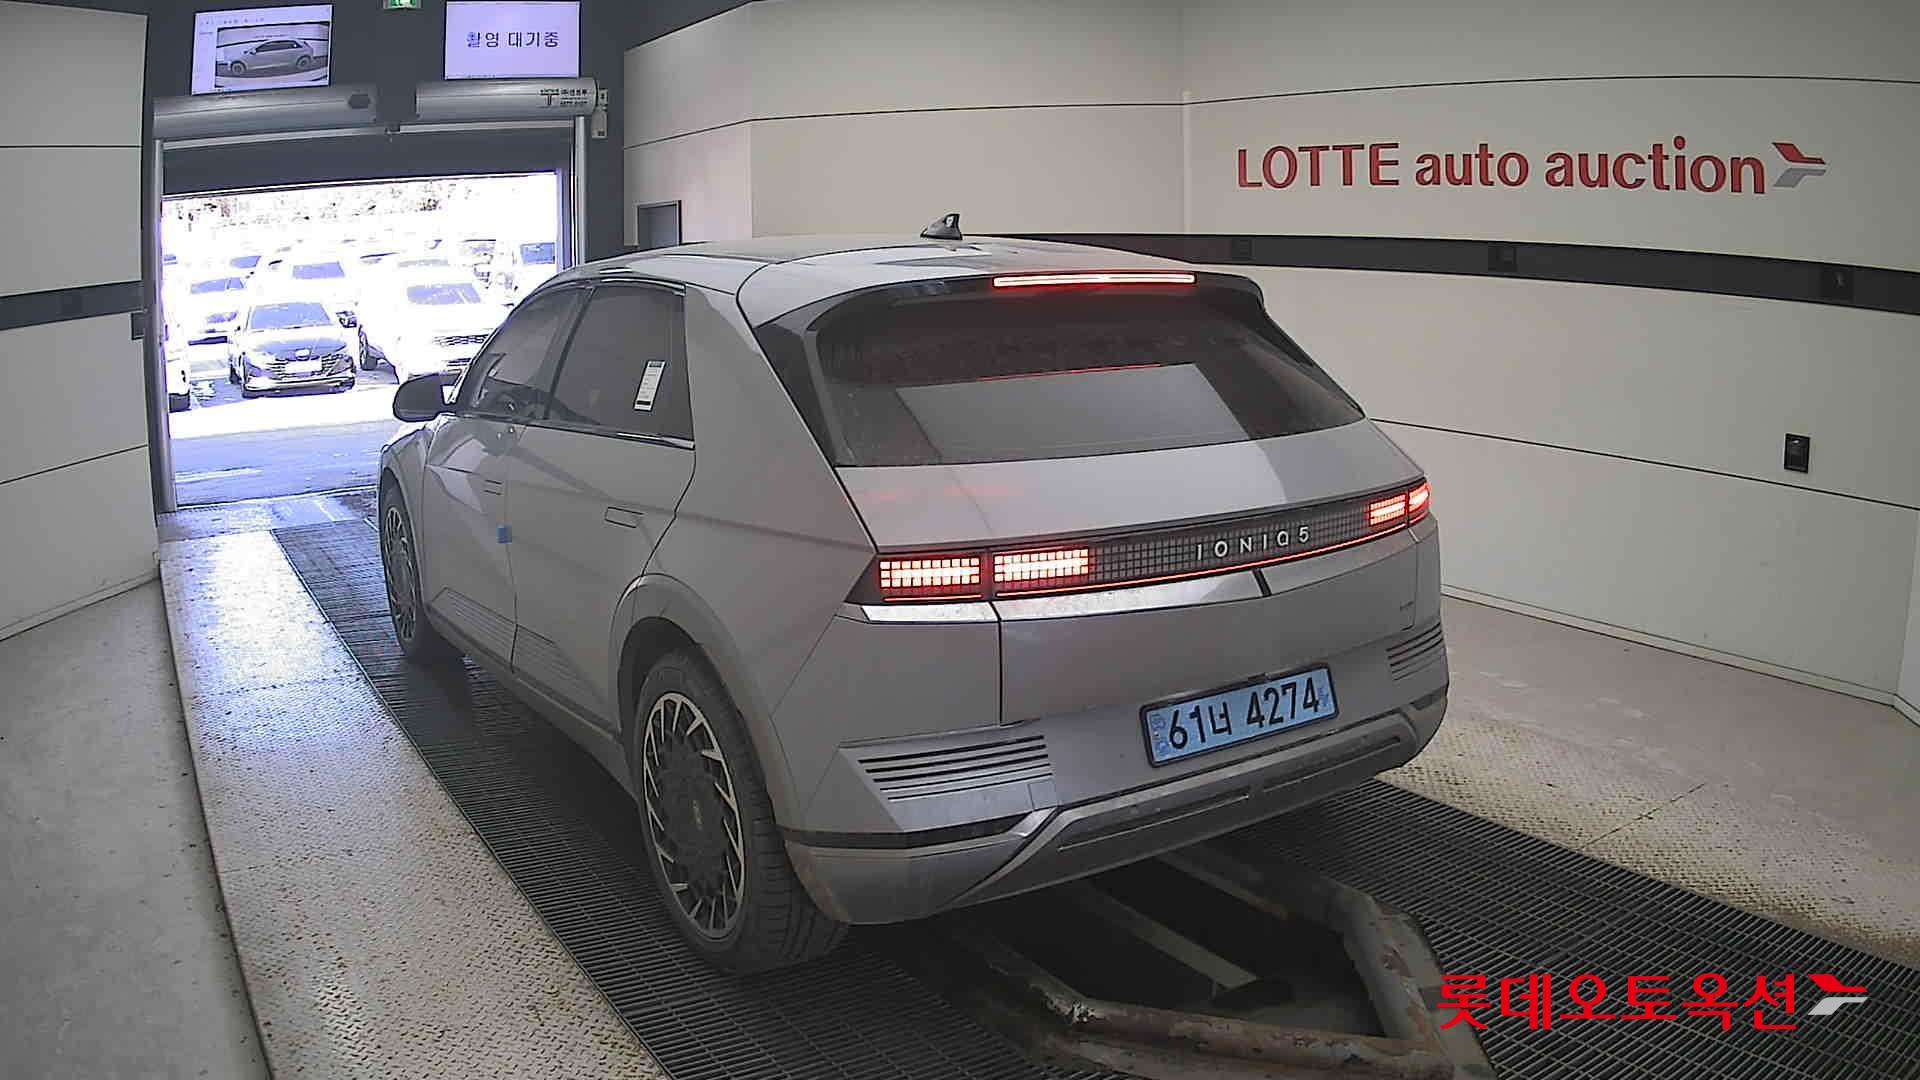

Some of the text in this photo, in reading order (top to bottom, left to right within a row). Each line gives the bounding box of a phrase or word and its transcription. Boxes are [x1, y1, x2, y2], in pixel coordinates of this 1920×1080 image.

[508, 31, 559, 48] 대기중
[1237, 136, 1766, 194] LOTTE auto auction
[1169, 676, 1320, 749] 61너 4274
